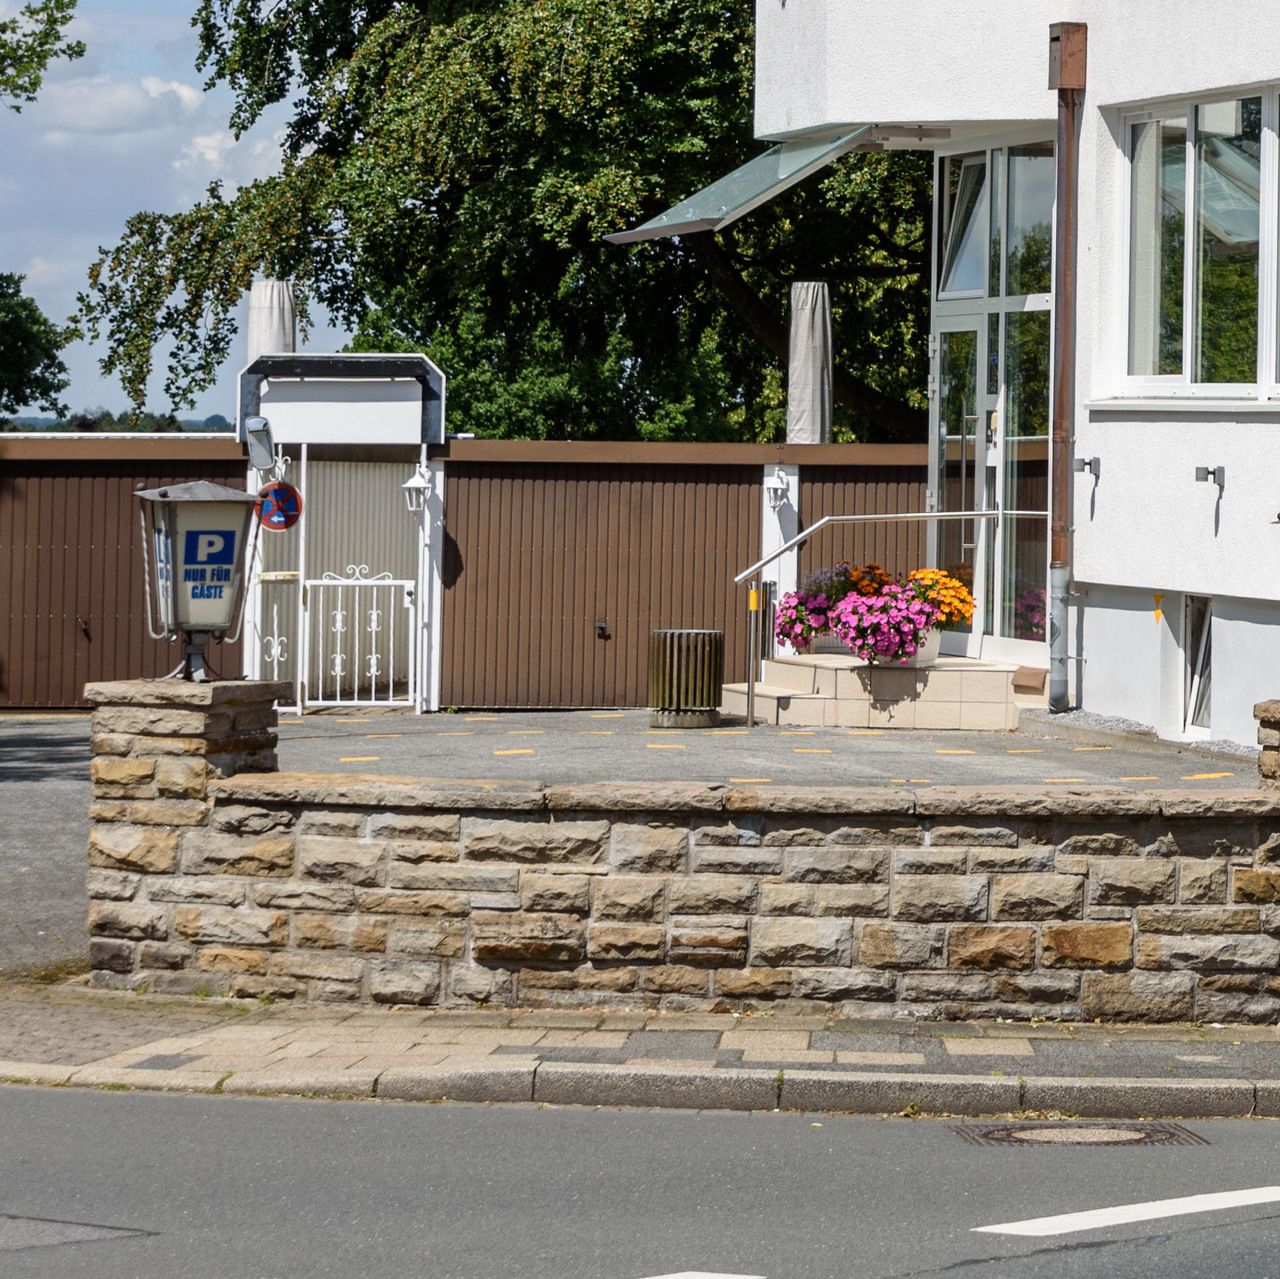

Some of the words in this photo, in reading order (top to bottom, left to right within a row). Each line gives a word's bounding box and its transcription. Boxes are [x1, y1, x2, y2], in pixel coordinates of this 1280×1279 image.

[196, 534, 224, 561] P
[184, 568, 207, 582] NUR
[211, 565, 231, 582] FÜR
[191, 583, 224, 599] GÄSTE
